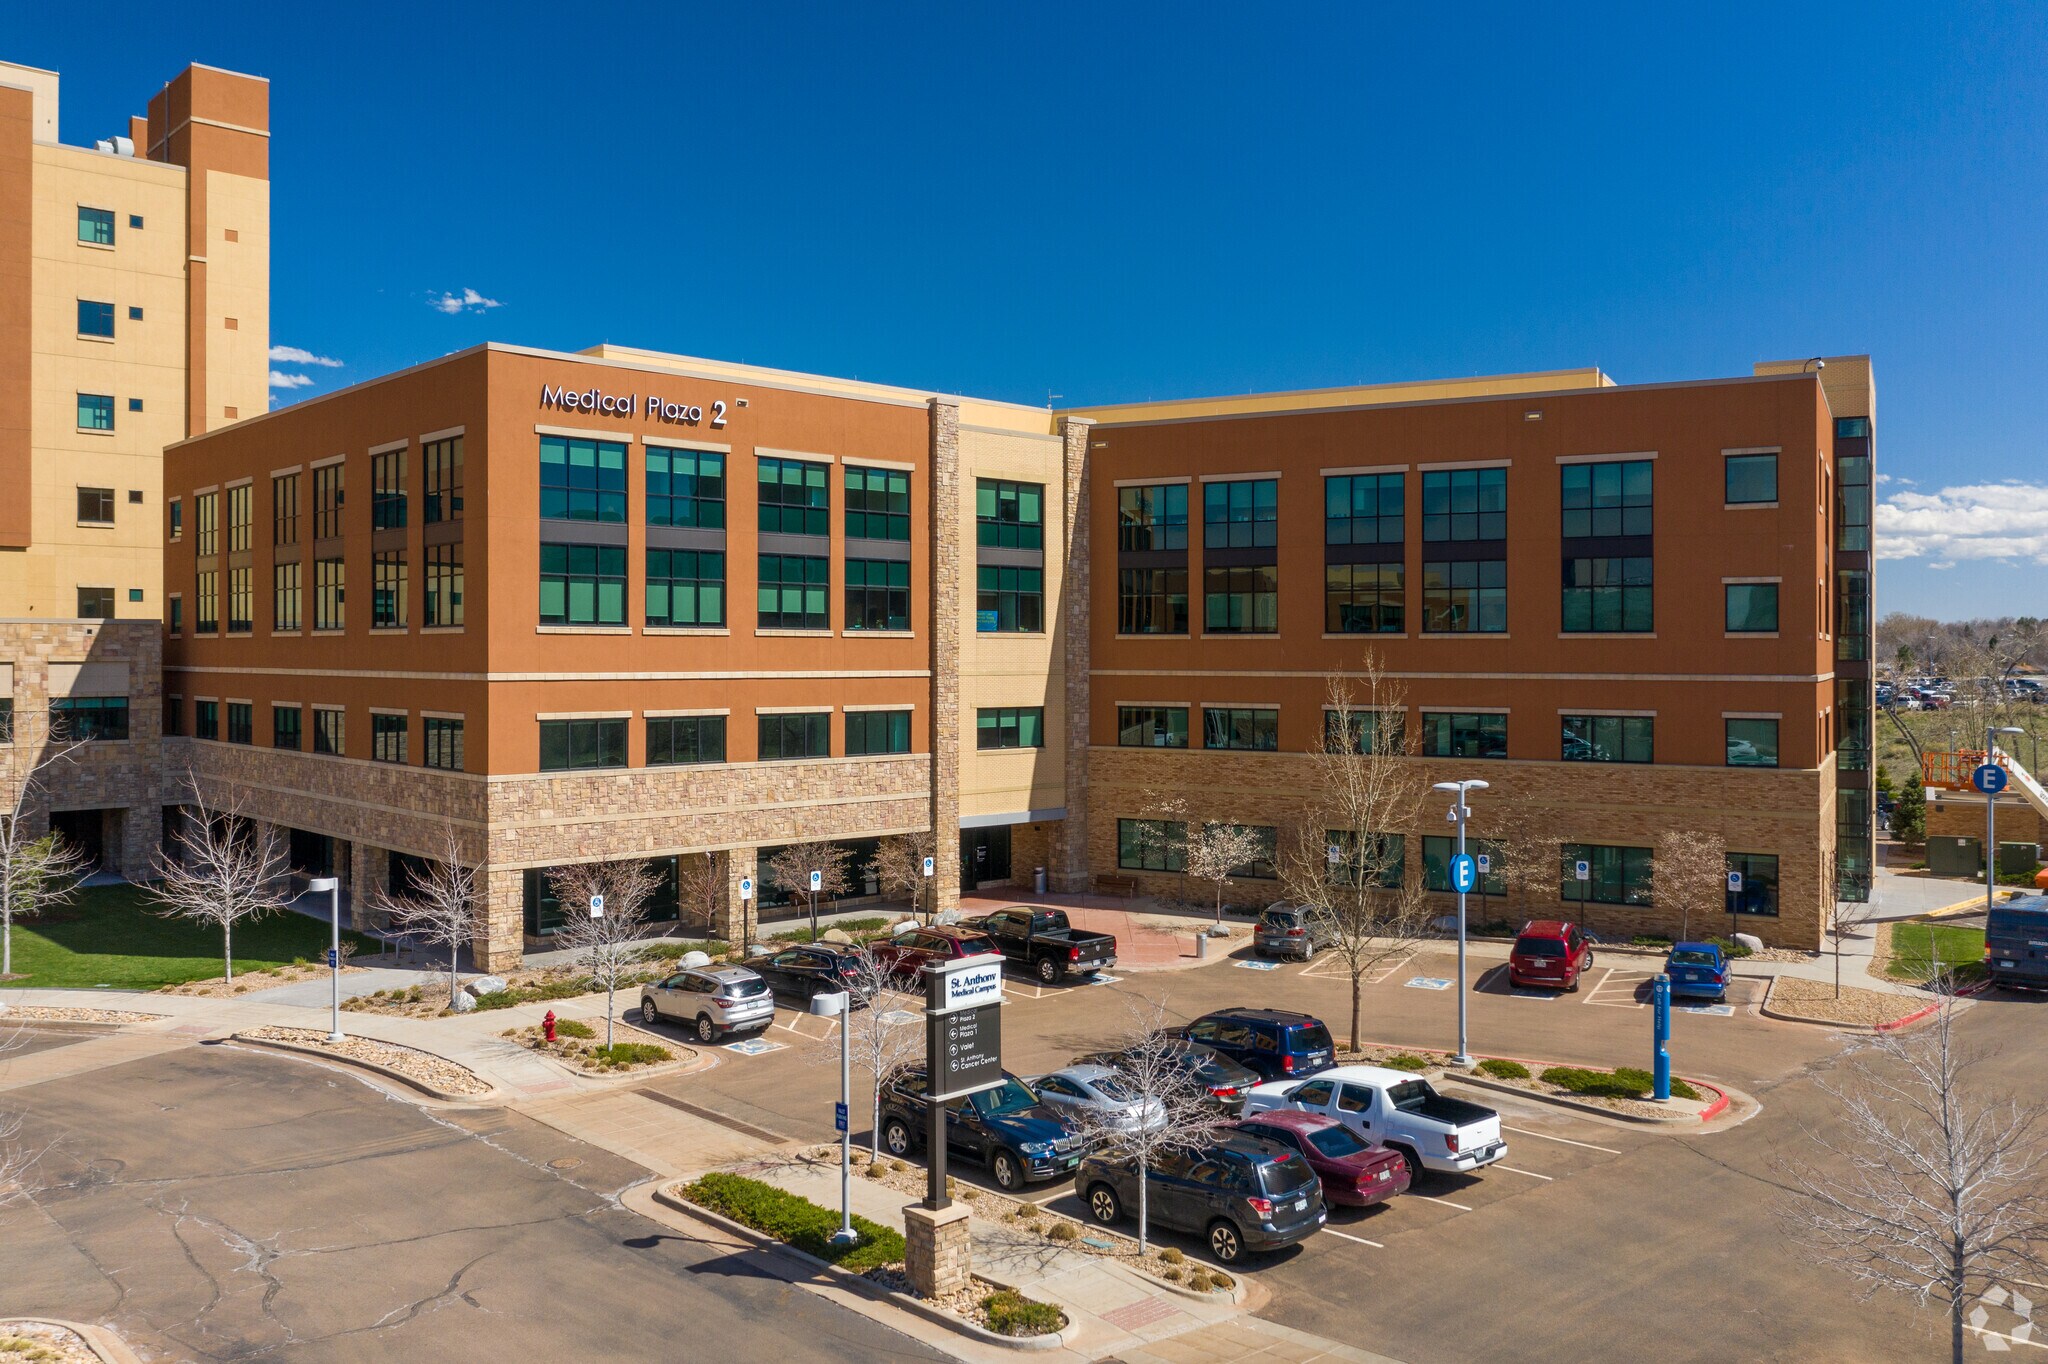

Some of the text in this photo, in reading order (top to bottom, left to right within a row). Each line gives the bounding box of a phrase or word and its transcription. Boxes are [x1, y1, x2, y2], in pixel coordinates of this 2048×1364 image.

[543, 384, 728, 425] Medical Plaza 2
[1983, 769, 1996, 789] E
[1459, 860, 1469, 887] E
[951, 973, 997, 989] St. Anthony
[951, 984, 997, 998] Medical Campus
[960, 1008, 977, 1016] Medical
[960, 1023, 978, 1031] Medical
[960, 1042, 975, 1050] Valet
[961, 1056, 998, 1070] Cancer Center
[966, 1053, 985, 1062] Anthony
